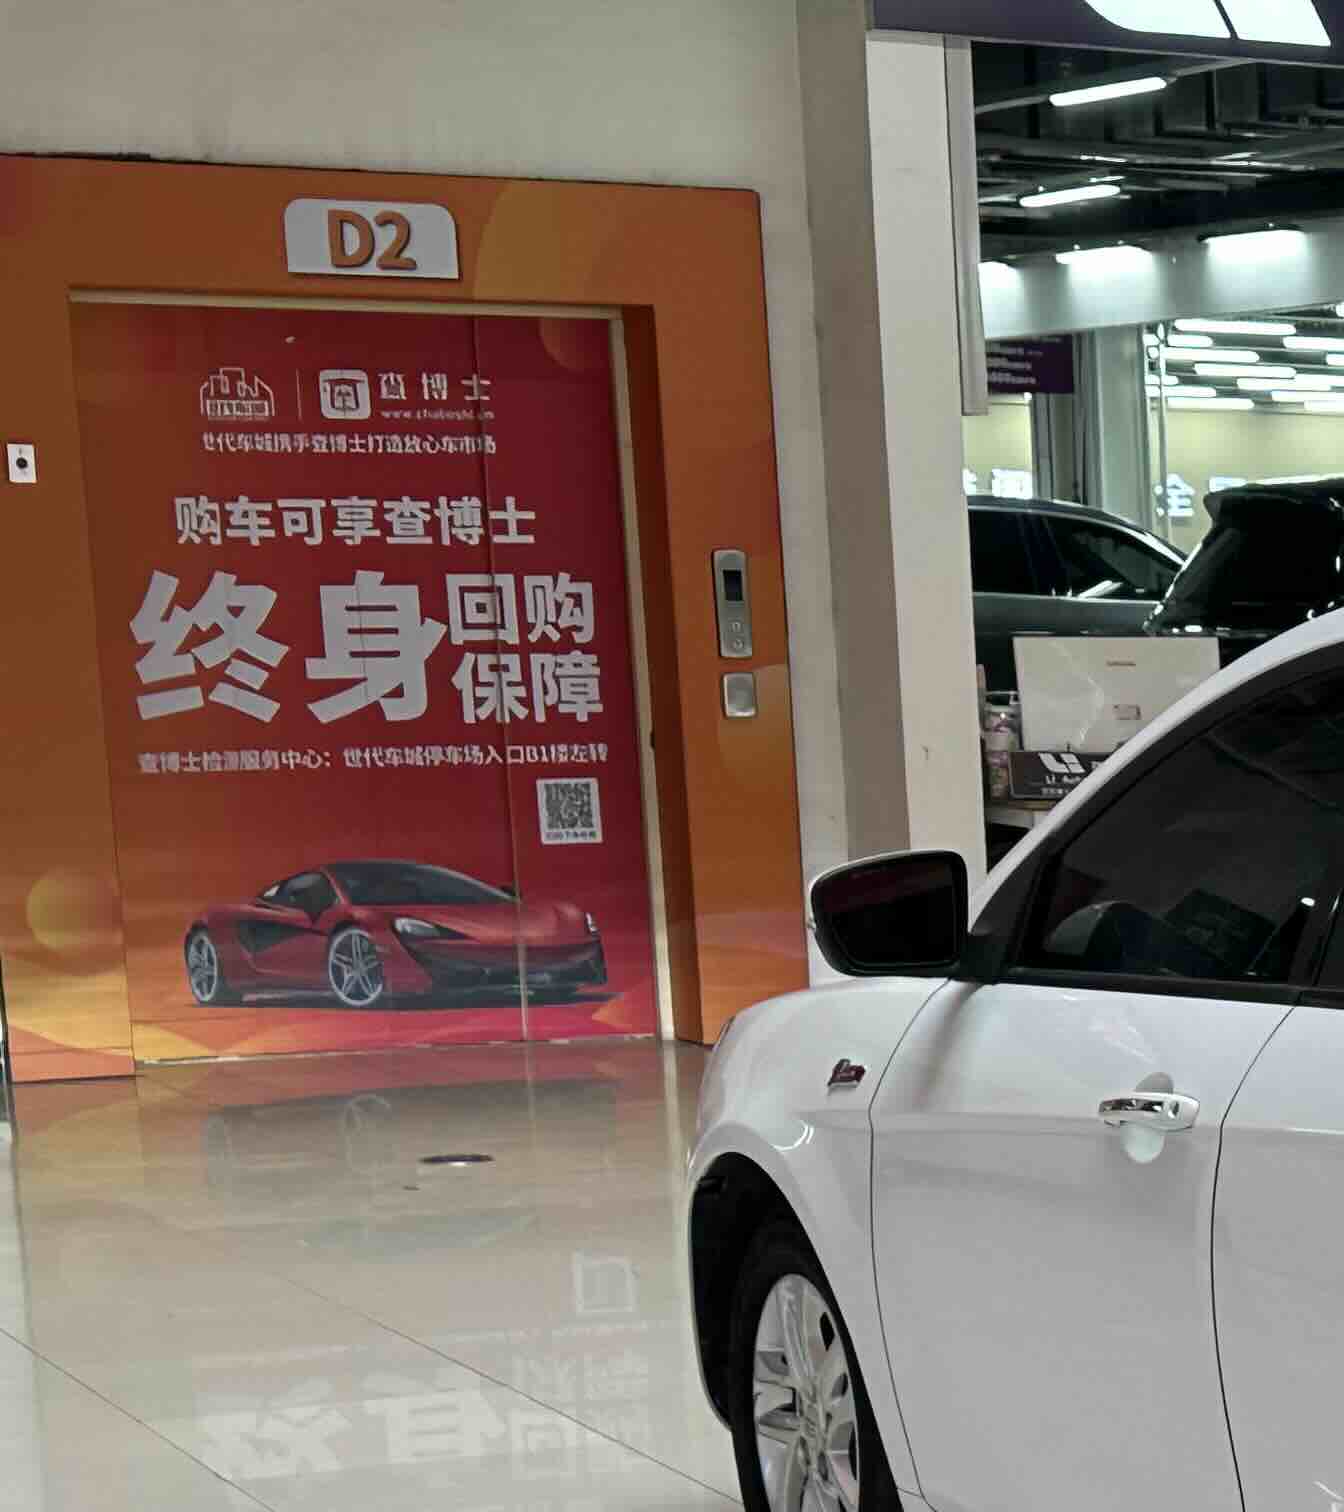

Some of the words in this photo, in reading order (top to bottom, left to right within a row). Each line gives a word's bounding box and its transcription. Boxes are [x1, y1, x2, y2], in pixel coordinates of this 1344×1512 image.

[327, 208, 417, 271] D2
[175, 496, 537, 547] 购车可享查博士
[130, 570, 447, 724] 终身
[446, 571, 595, 645] 回购
[450, 652, 607, 724] 保障
